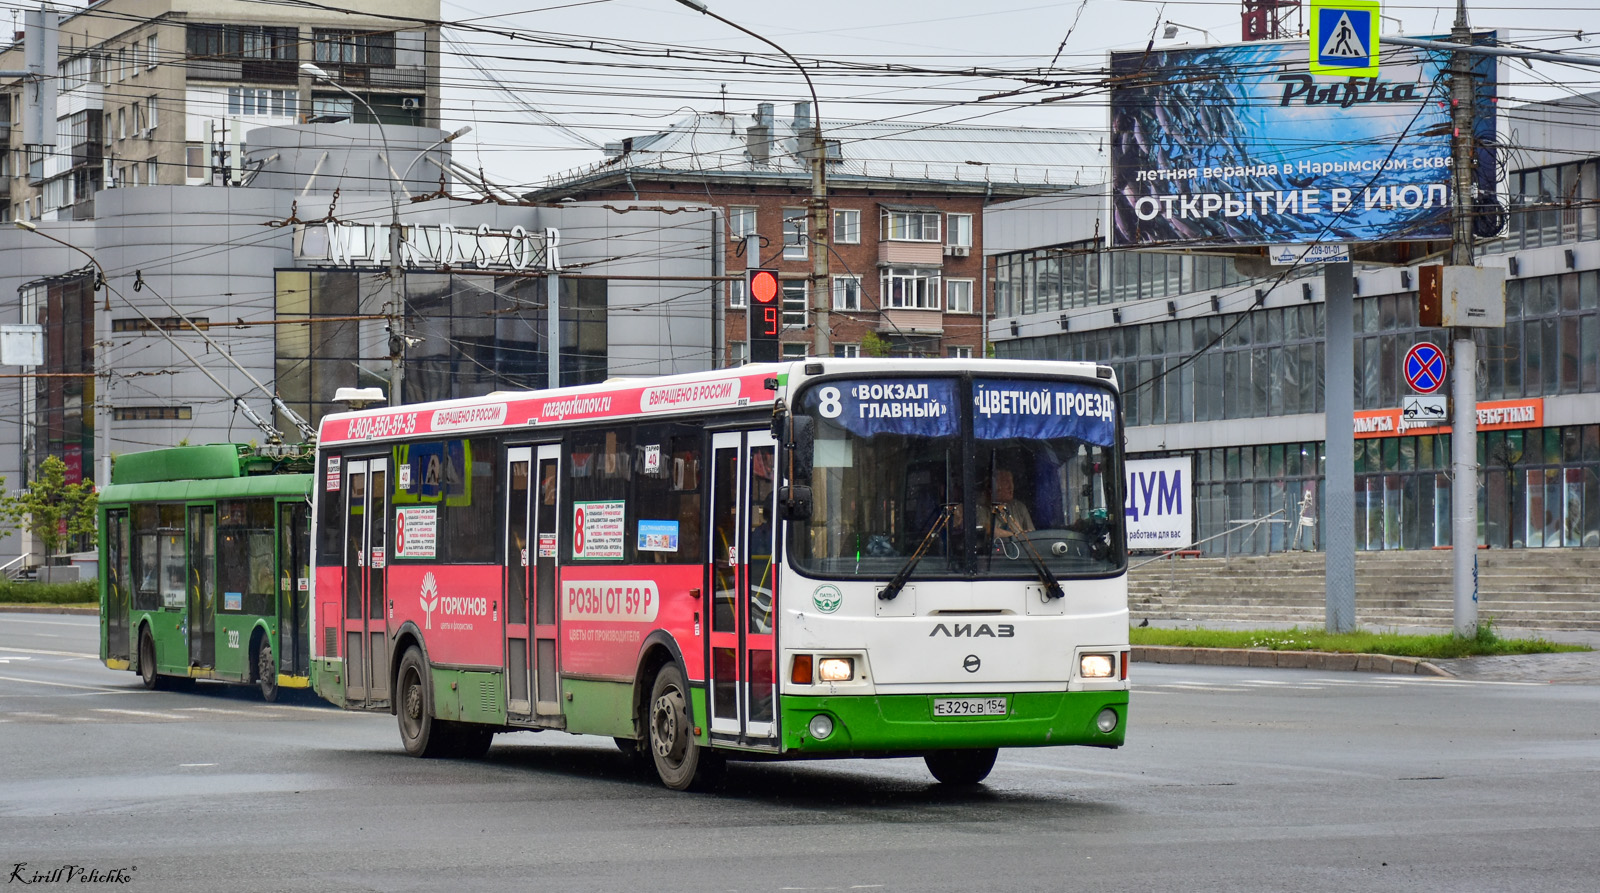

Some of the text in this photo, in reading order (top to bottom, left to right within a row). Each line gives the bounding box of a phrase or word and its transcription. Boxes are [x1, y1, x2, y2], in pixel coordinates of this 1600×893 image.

[1277, 74, 1421, 108] Рыбка
[1136, 155, 1454, 182] летняя веранда в Нарымском скве
[1134, 183, 1448, 221] ОТКРЫТИЕ В ИЮЛ
[326, 221, 562, 271] WINDSOR
[1311, 245, 1340, 255] 209-01-01
[764, 307, 777, 335] 9
[649, 382, 733, 405] ВЫРАЩЕНО В РОССИИ
[818, 386, 843, 419] 8
[851, 383, 929, 400] «ВОКЗАЛ
[437, 409, 470, 426] ВЫРАЩЕНО
[475, 406, 501, 421] РОССИИ
[541, 394, 612, 420] rozagorkunov.ru
[859, 399, 947, 418] ГЛАВНЫЙ»
[347, 413, 417, 439] 8-800-550-59-35
[396, 512, 405, 554] 8
[574, 507, 585, 554] 8
[1129, 530, 1181, 541] работаем для вас
[440, 596, 487, 616] ГОРКУНОВ
[568, 587, 652, 615] РОЗЫ ОТ 59 Р
[569, 629, 640, 643] ЦВЕТЫ ОТ ПРОИЗВОДИТЕЛЯ
[929, 623, 1015, 637] ЛИАЗ
